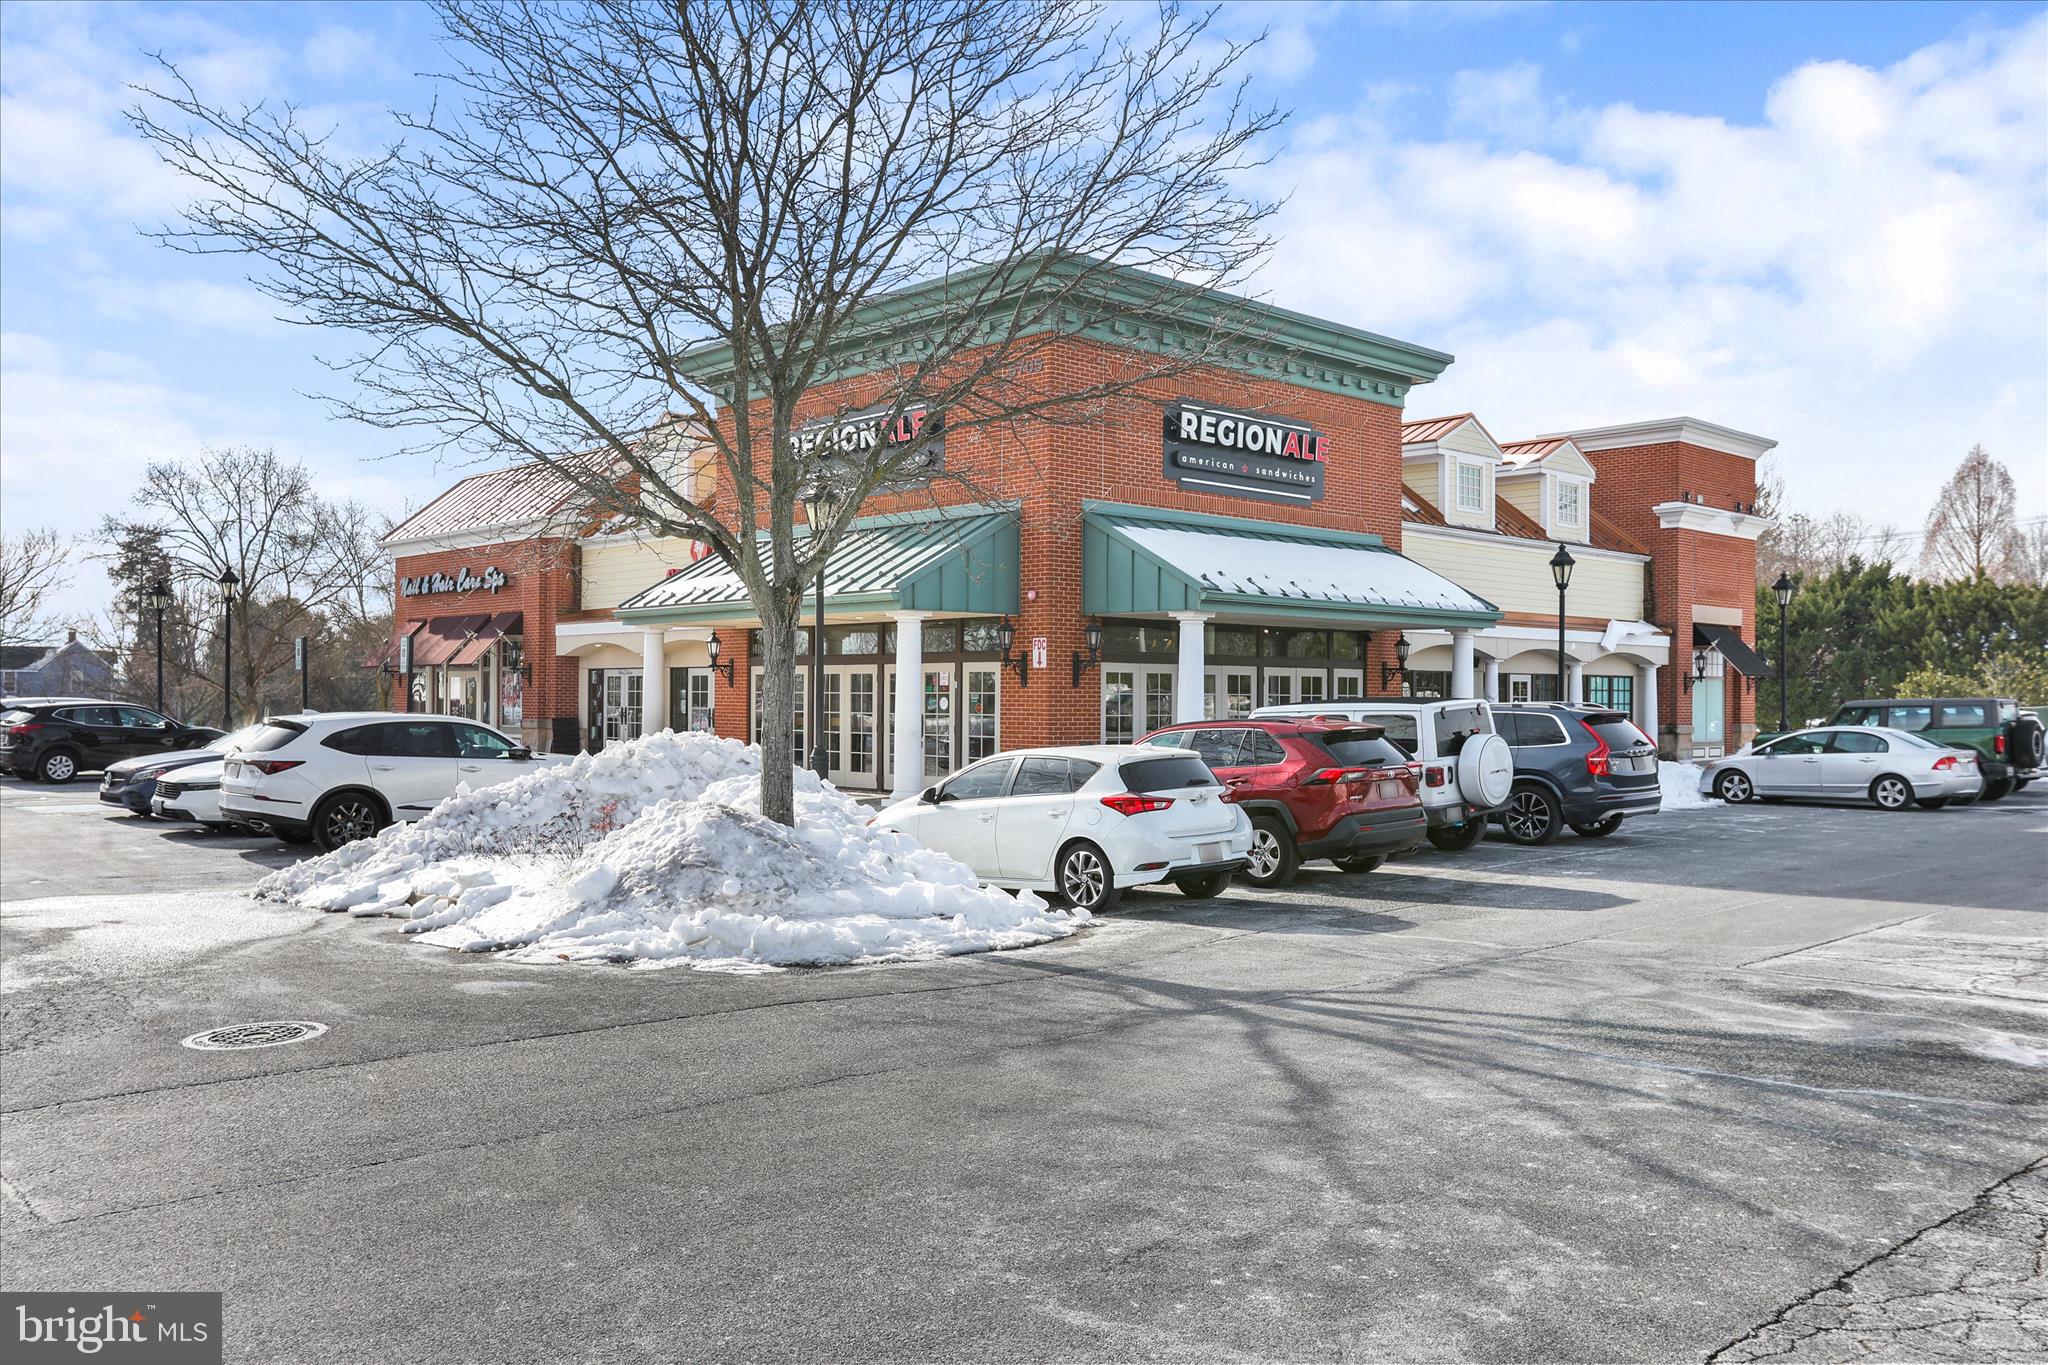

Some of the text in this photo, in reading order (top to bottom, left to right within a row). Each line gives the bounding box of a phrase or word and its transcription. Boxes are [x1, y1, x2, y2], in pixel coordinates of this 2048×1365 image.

[1180, 411, 1329, 464] REGIONALE
[1181, 454, 1316, 484] american sandwiches
[484, 566, 505, 595] Spa
[1033, 639, 1046, 650] FDC
